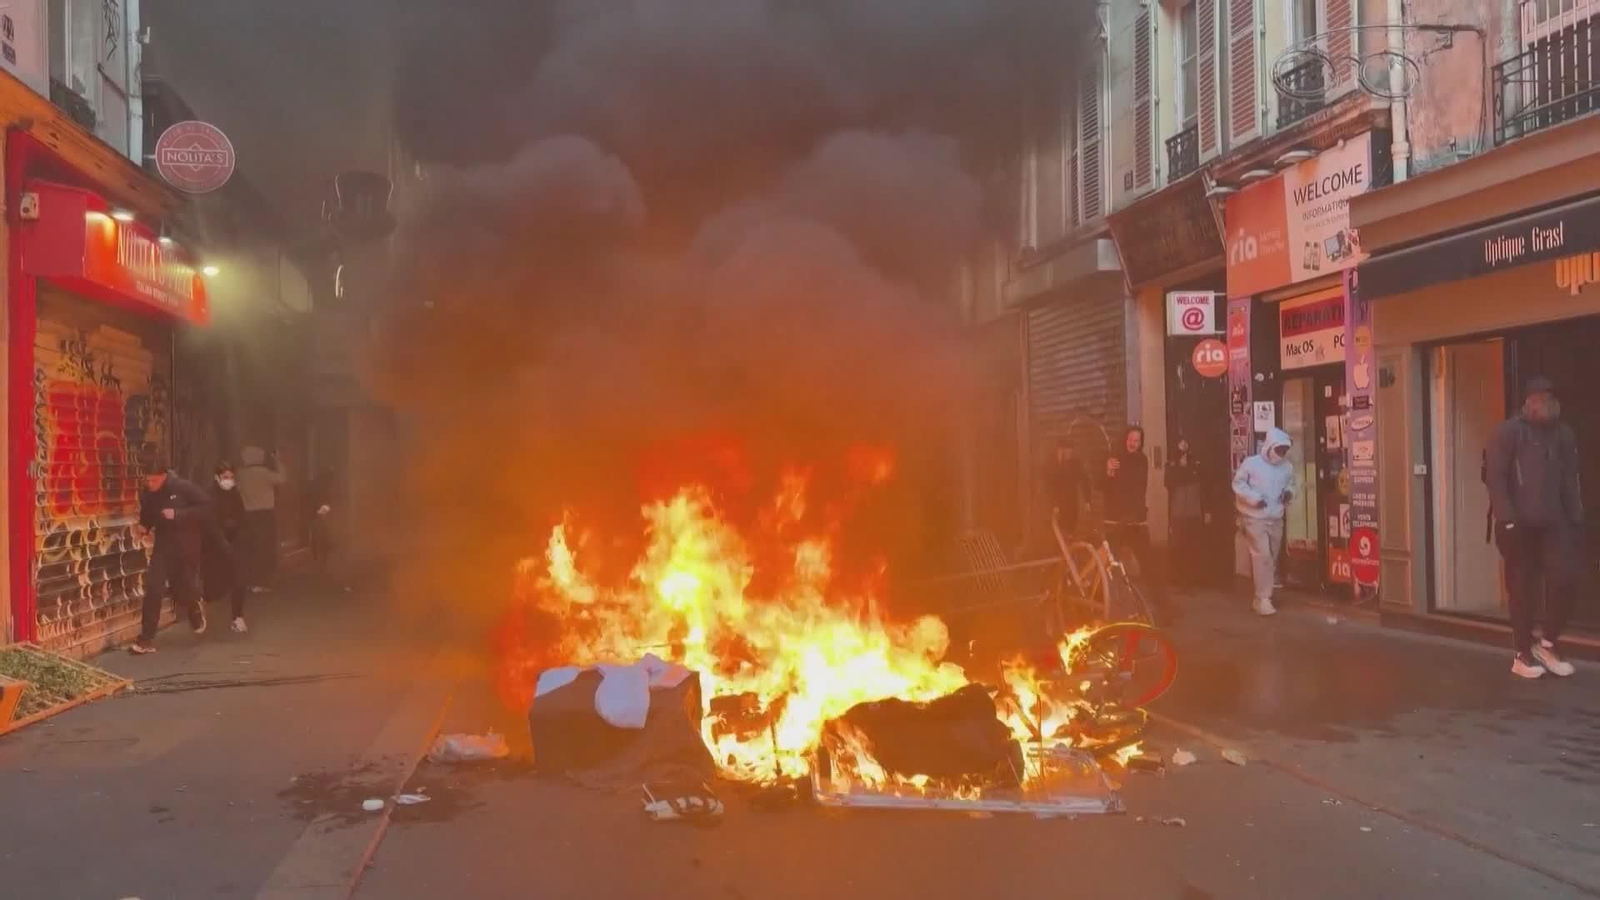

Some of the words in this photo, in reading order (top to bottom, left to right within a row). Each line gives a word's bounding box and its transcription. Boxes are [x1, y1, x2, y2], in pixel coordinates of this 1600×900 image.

[166, 151, 224, 163] NOLITA'S
[1293, 164, 1363, 207] WELCOME
[1230, 226, 1258, 268] ria
[1485, 235, 1525, 267] Optique
[1176, 296, 1210, 306] WELCOME
[1182, 307, 1205, 331] @
[1197, 343, 1225, 363] ria
[1333, 333, 1346, 350] PC
[1332, 554, 1350, 577] ria
